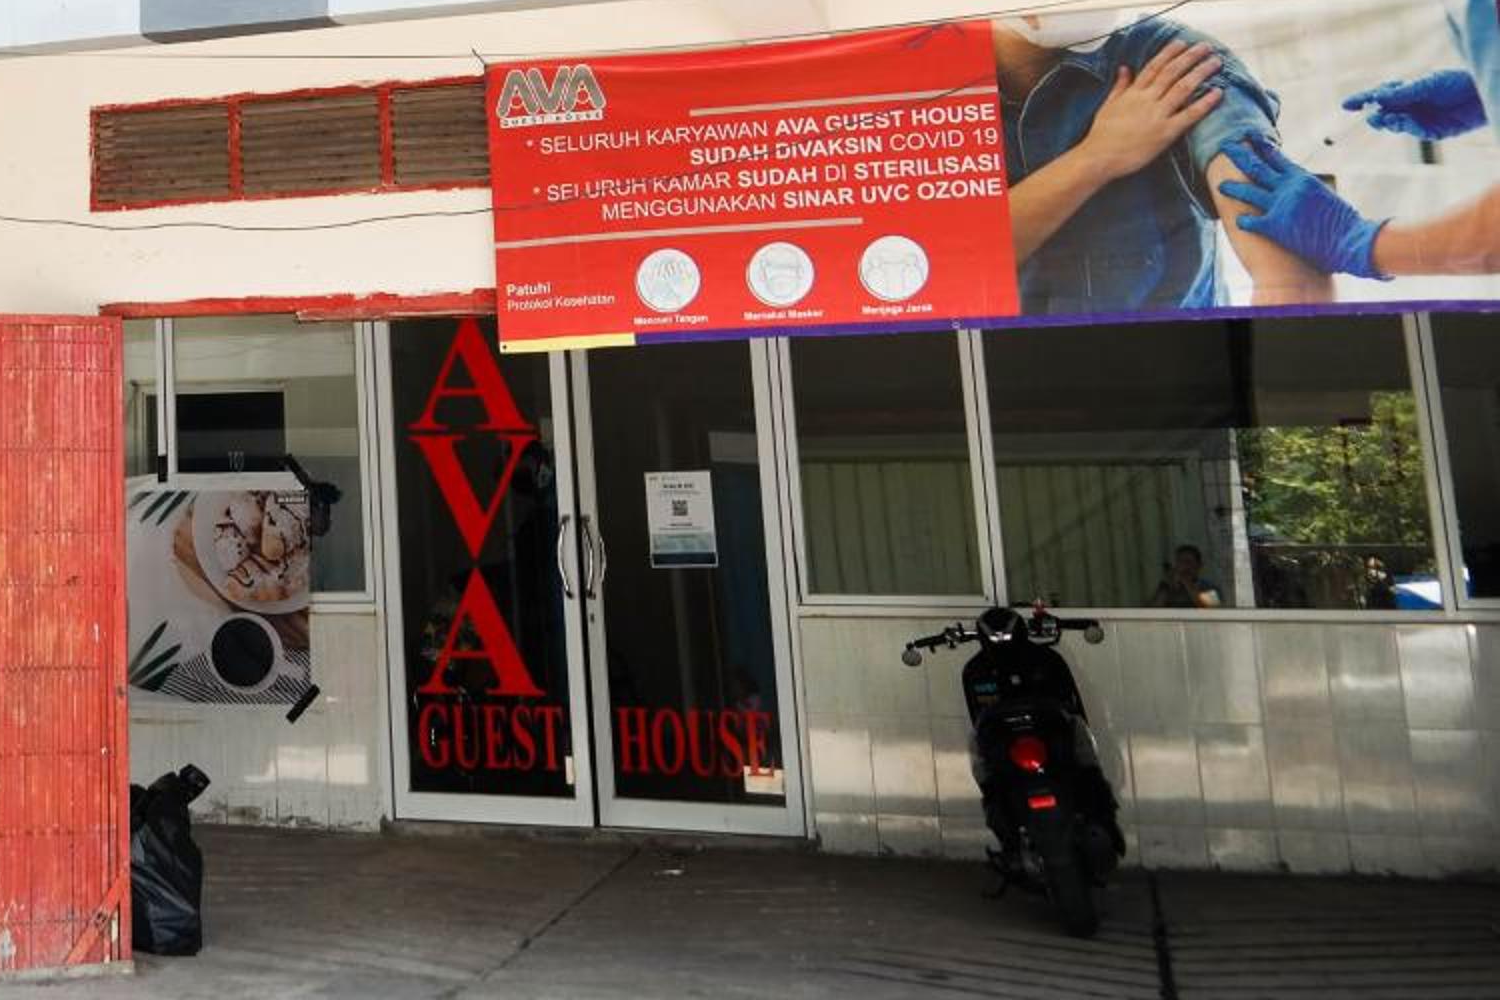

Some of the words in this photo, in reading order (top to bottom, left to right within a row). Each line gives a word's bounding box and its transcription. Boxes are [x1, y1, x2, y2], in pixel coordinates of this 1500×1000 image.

[496, 64, 606, 118] AVA
[540, 129, 640, 155] SELURUH
[647, 120, 768, 146] KARYAWAN
[775, 118, 820, 136] AVA
[825, 110, 903, 131] GUEST
[911, 103, 996, 126] HOUSE
[690, 143, 768, 165] SUDAH
[775, 135, 882, 160] DIVAKSIN
[889, 129, 964, 151] COVID
[974, 127, 998, 145] 19
[547, 178, 647, 202] SELURUH
[652, 171, 731, 193] KAMAR
[738, 166, 817, 188] SUDAH
[825, 164, 847, 182] DI
[854, 153, 1000, 180] STERILISASI
[602, 192, 776, 220] MENGGUNAKAN
[783, 187, 854, 209] SINAR
[861, 184, 910, 204] UVC
[917, 178, 1003, 199] OZONE
[506, 282, 551, 297] Patuhi
[408, 316, 546, 697] AVA
[417, 704, 563, 772] GUEST
[618, 707, 775, 779] HOUSE
